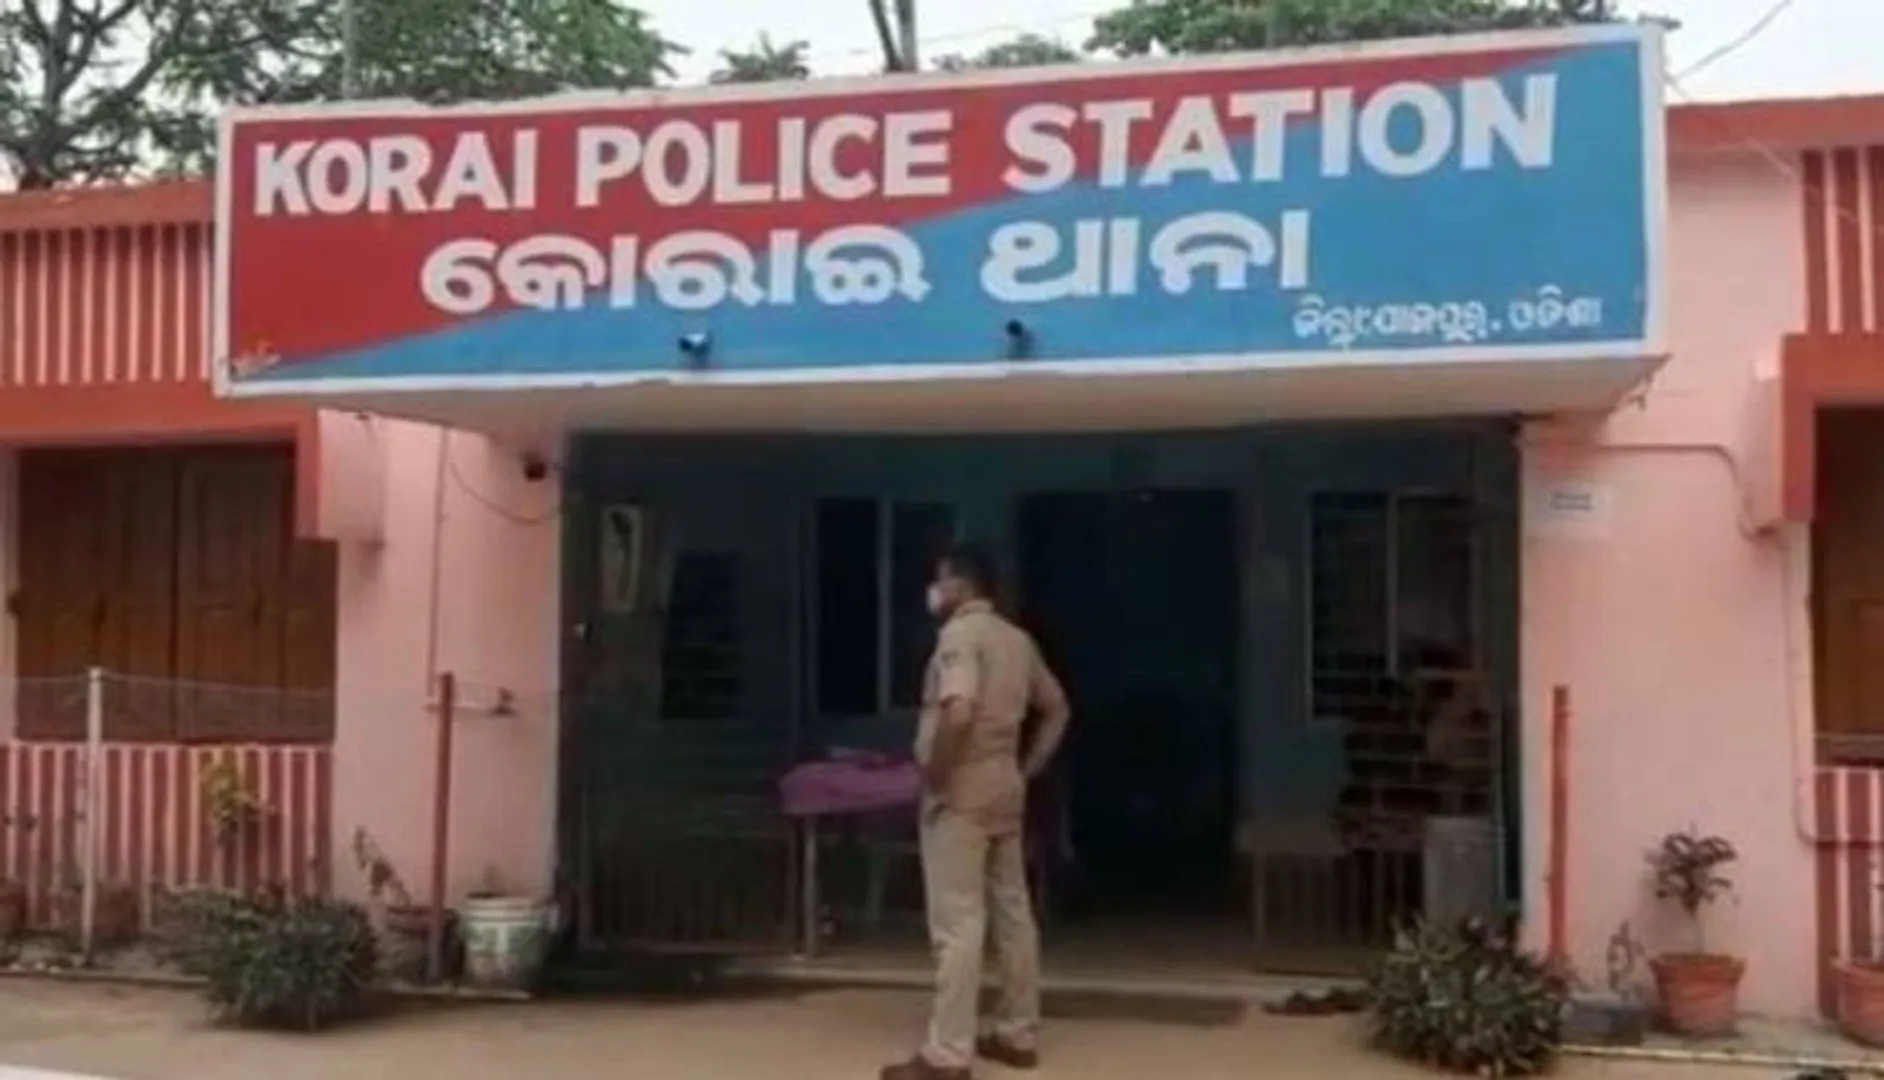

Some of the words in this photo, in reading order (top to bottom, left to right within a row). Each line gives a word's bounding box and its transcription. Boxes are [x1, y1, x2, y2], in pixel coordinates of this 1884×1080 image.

[256, 130, 536, 214] KORAI
[577, 112, 951, 207] POLICE
[1004, 74, 1556, 192] STATION
[421, 225, 931, 313] କୋରାଇ
[981, 212, 1308, 301] ଥାନା
